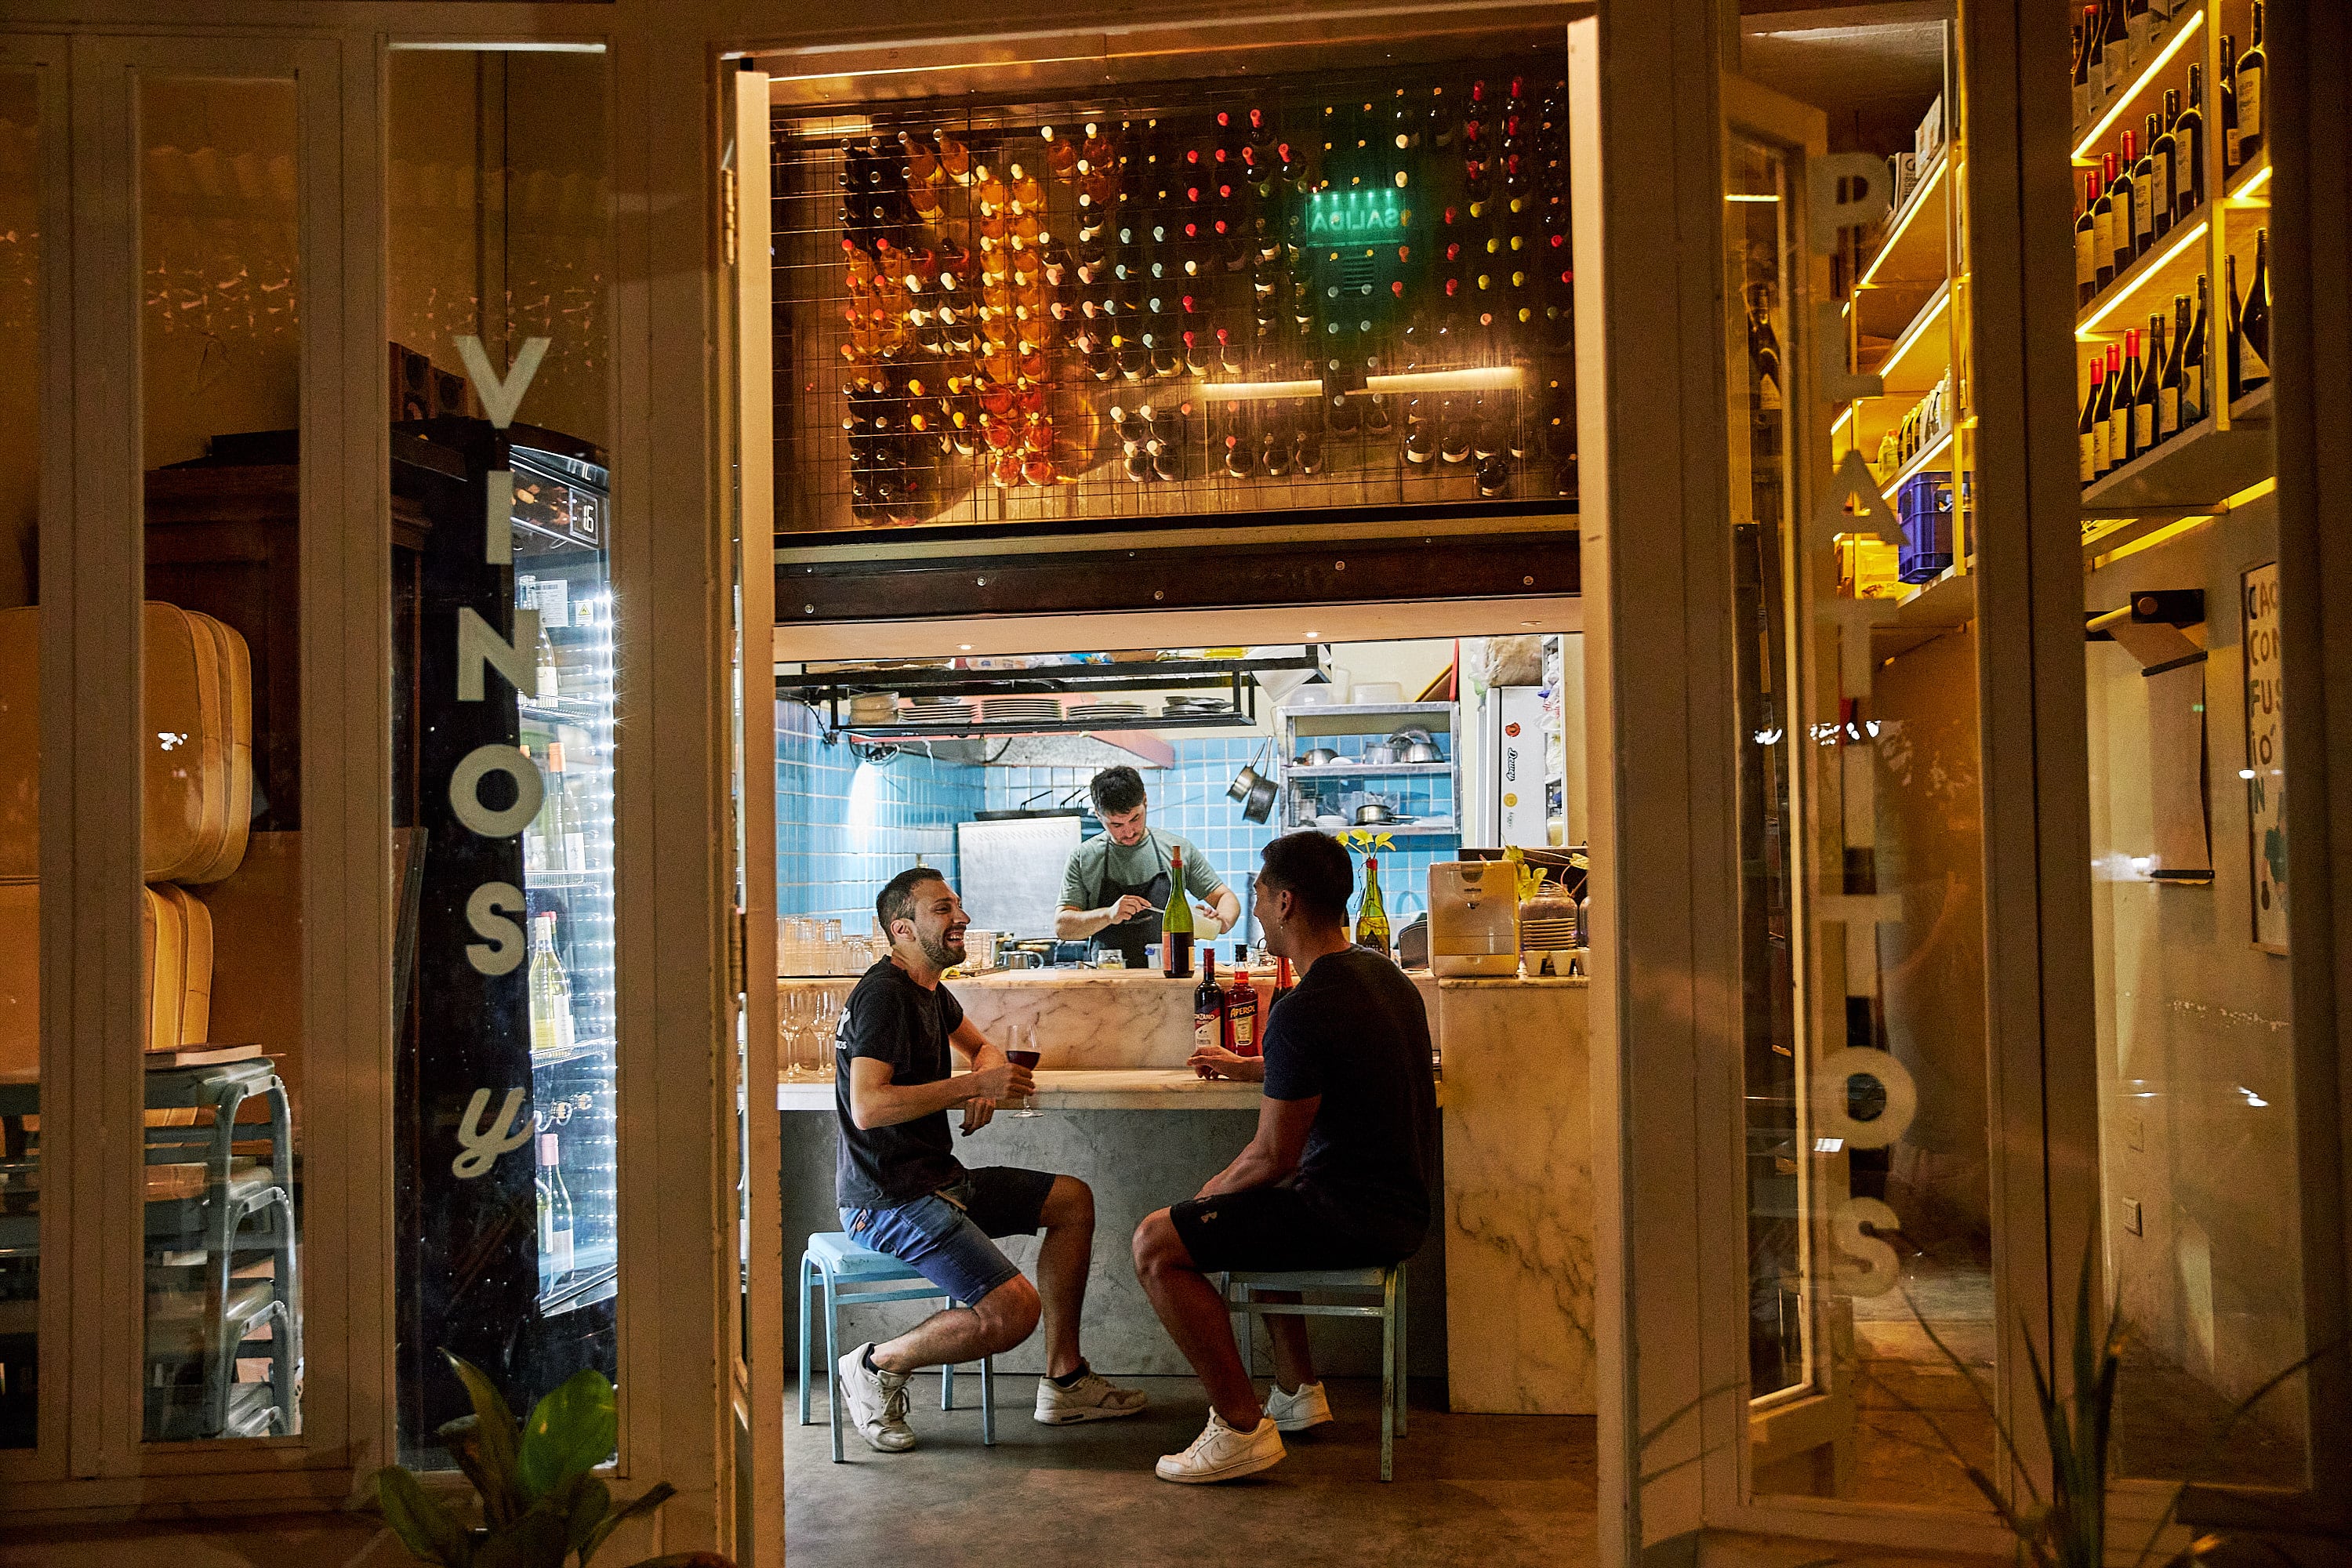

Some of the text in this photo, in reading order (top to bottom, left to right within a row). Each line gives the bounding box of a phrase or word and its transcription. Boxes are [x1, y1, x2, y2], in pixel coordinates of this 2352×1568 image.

[449, 334, 550, 975] VINOS
[1806, 152, 1918, 1298] PLATITOS
[1230, 1004, 1255, 1018] APEROL
